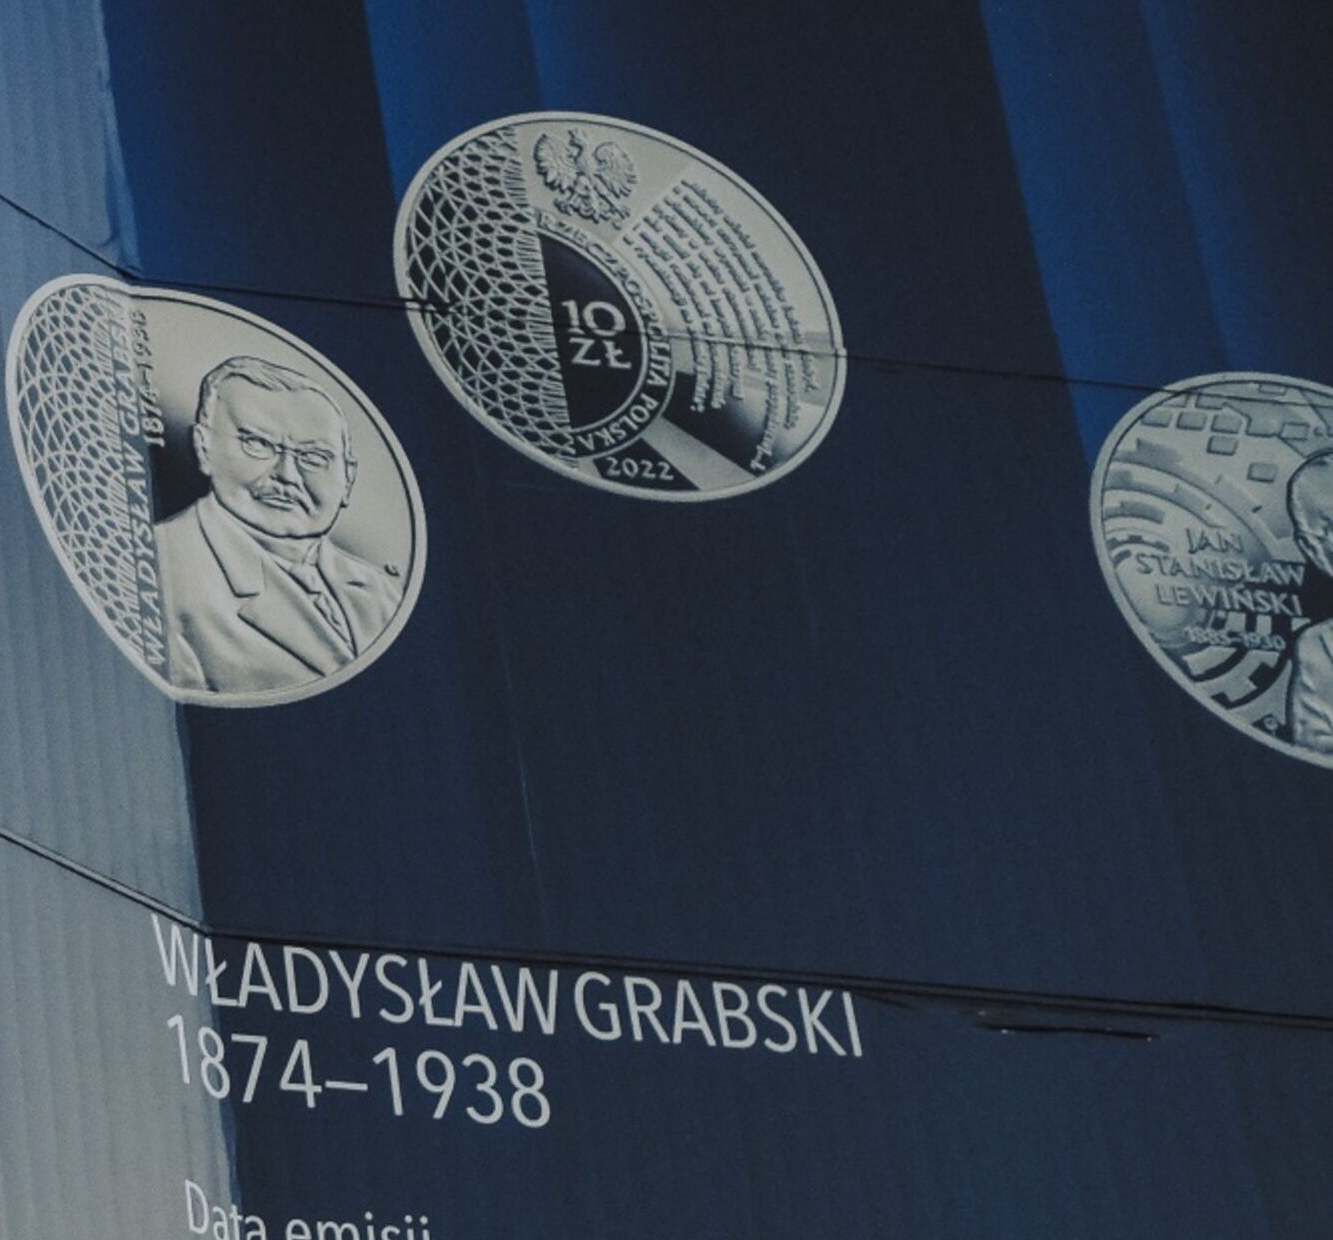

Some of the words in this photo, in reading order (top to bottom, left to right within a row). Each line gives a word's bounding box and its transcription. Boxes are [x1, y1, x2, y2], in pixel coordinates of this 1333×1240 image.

[560, 300, 626, 336] 10
[569, 337, 633, 369] ZŁ
[578, 392, 660, 453] POLSKA
[606, 456, 676, 483] 2022
[1186, 528, 1244, 554] JAN
[1136, 553, 1306, 588] STANISŁAW
[1156, 583, 1304, 617] LEWIŃSKI
[151, 914, 559, 1035] WŁADYSŁAW
[574, 971, 864, 1058] GRABSKI
[167, 1014, 551, 1129] 1874–1938
